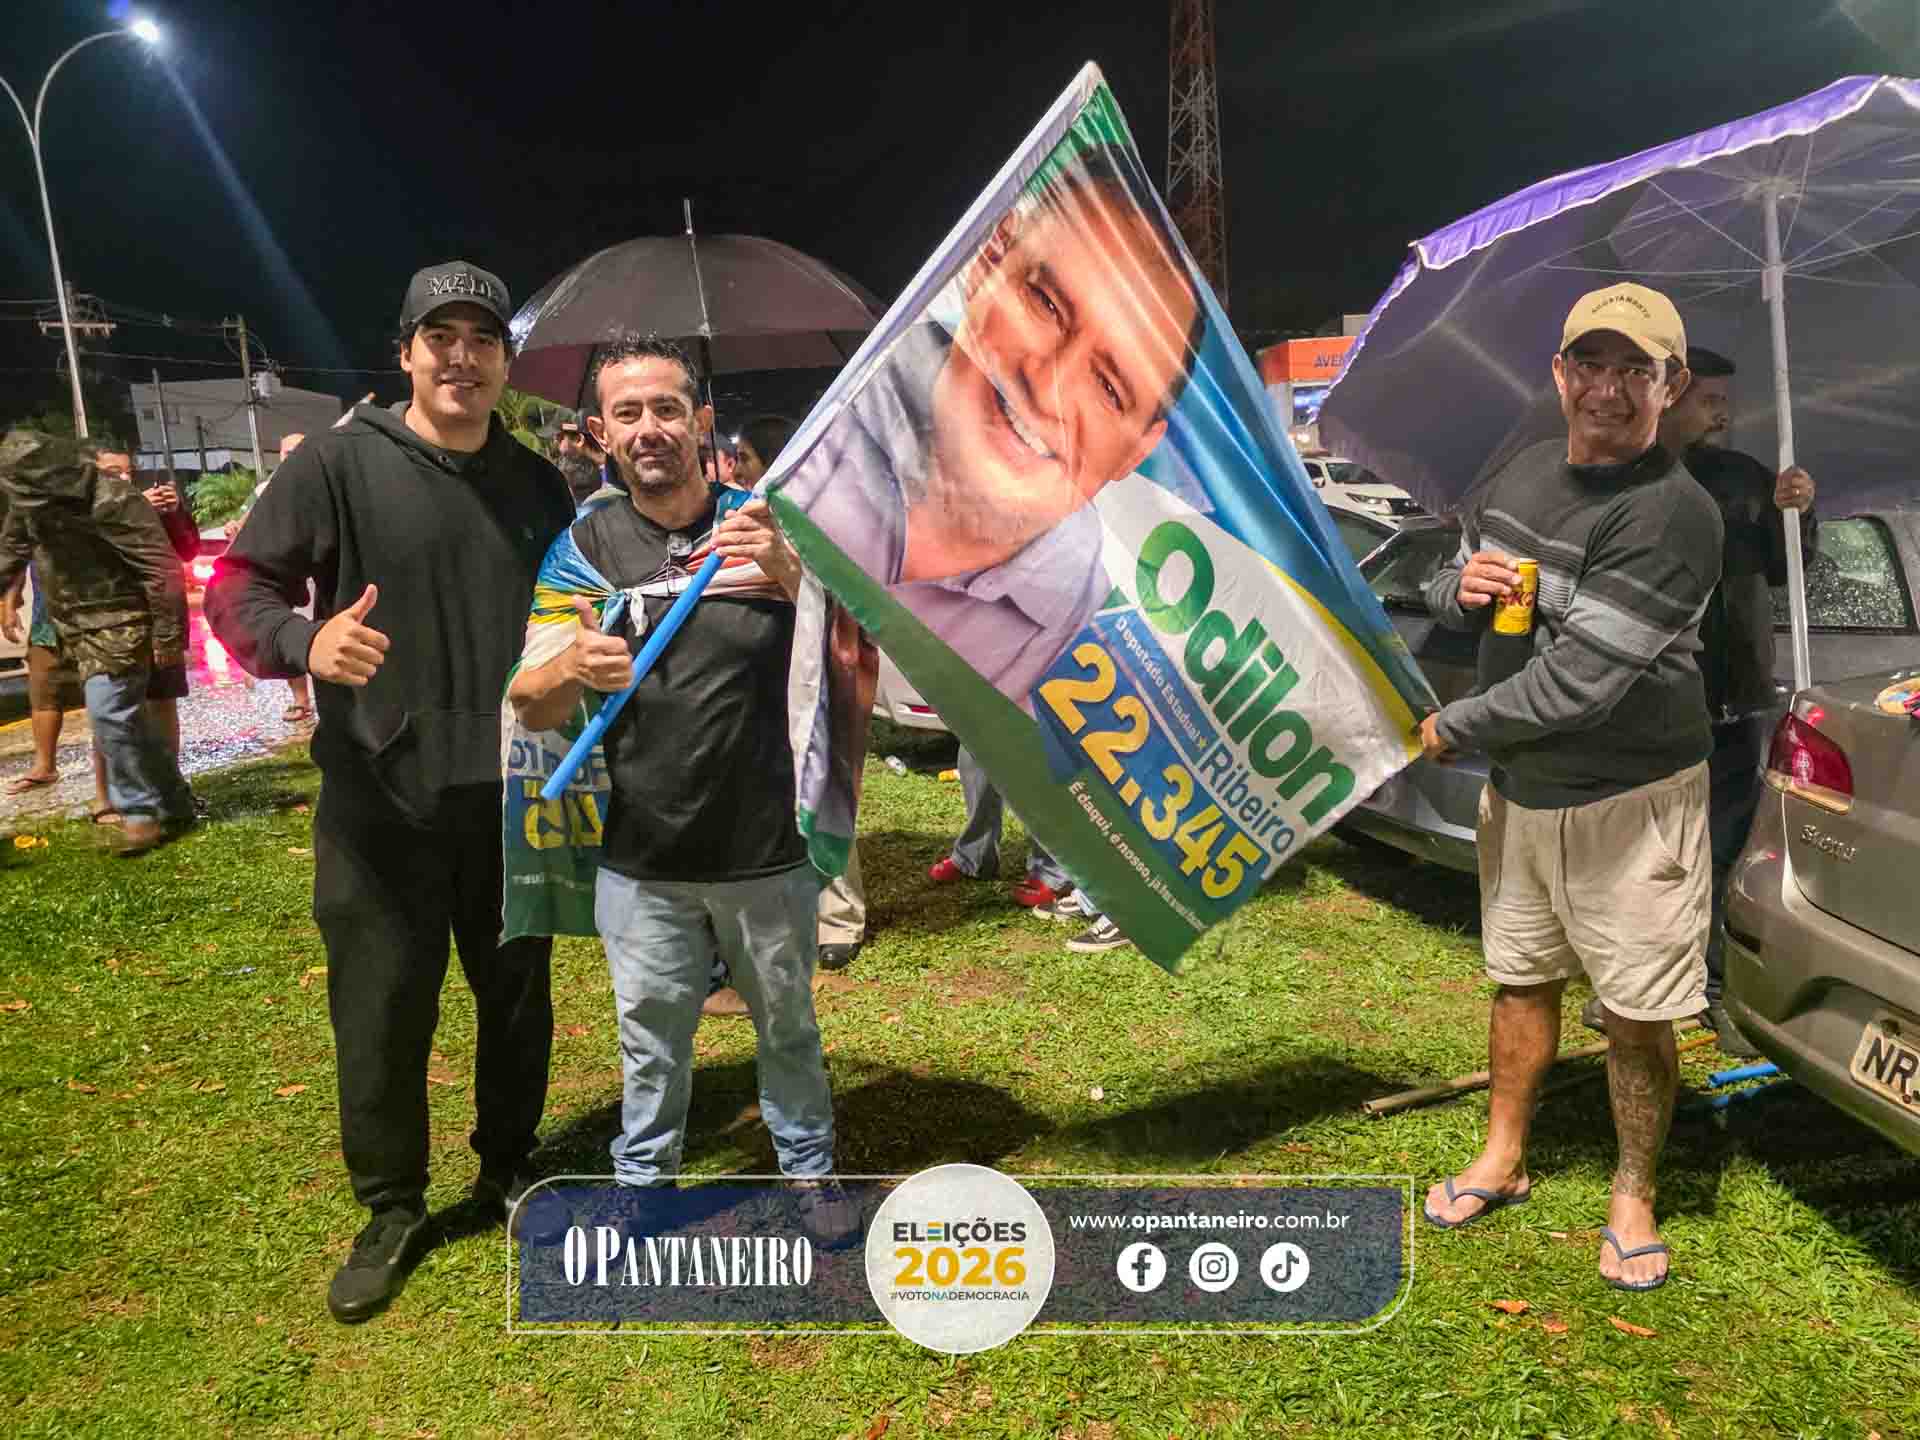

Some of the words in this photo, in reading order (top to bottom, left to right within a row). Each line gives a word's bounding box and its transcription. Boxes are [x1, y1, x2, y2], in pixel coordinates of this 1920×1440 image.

[1114, 616, 1167, 692] Deputado
[1160, 683, 1203, 749] Estadual
[1136, 520, 1357, 826] Odilon
[1039, 642, 1262, 899] 22.345
[1200, 750, 1295, 857] Ribeiro
[1862, 1036, 1920, 1101] NR
